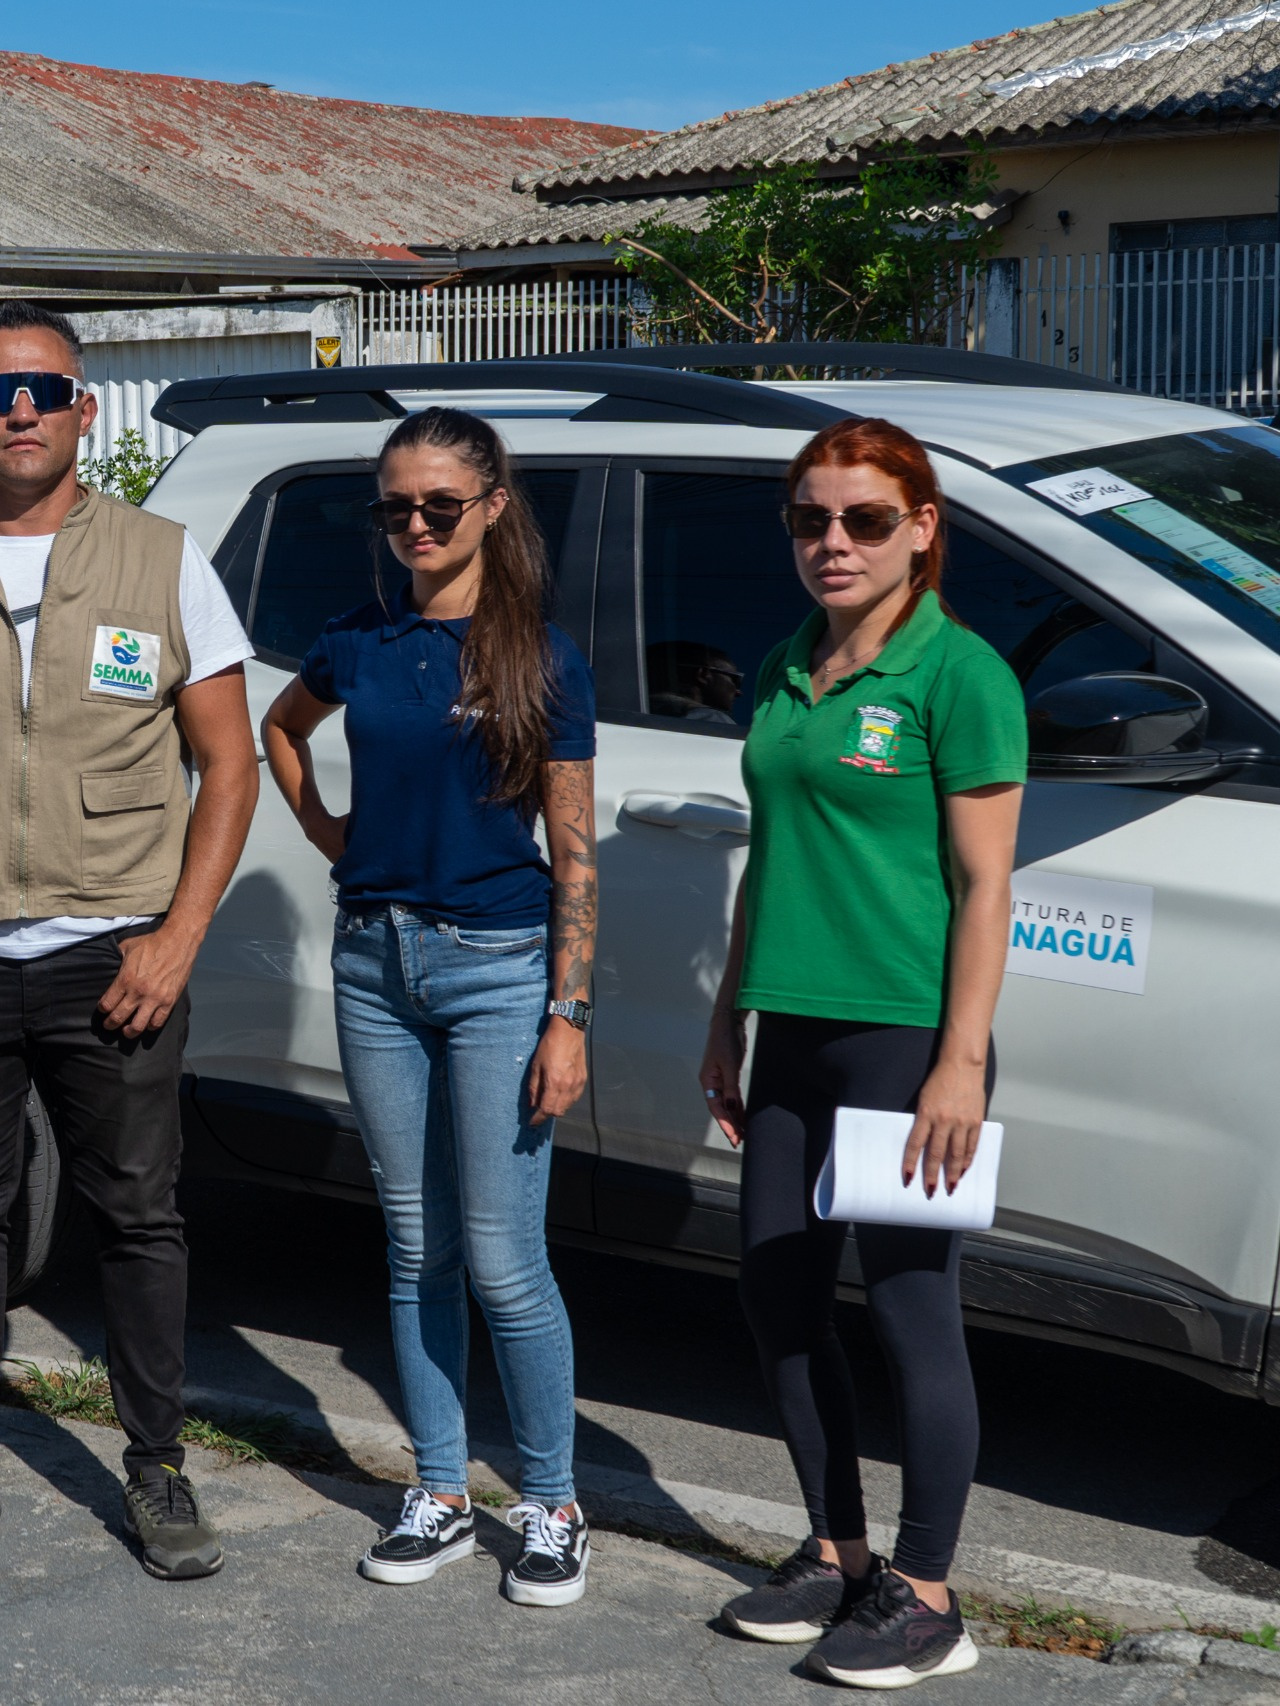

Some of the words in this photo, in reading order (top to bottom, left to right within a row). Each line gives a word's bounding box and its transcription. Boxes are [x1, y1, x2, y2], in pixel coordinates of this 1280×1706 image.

[93, 662, 154, 687] SEMMA
[1011, 900, 1087, 926] ITURA
[1101, 914, 1135, 933] DE
[1011, 921, 1136, 967] NAGUÁ
